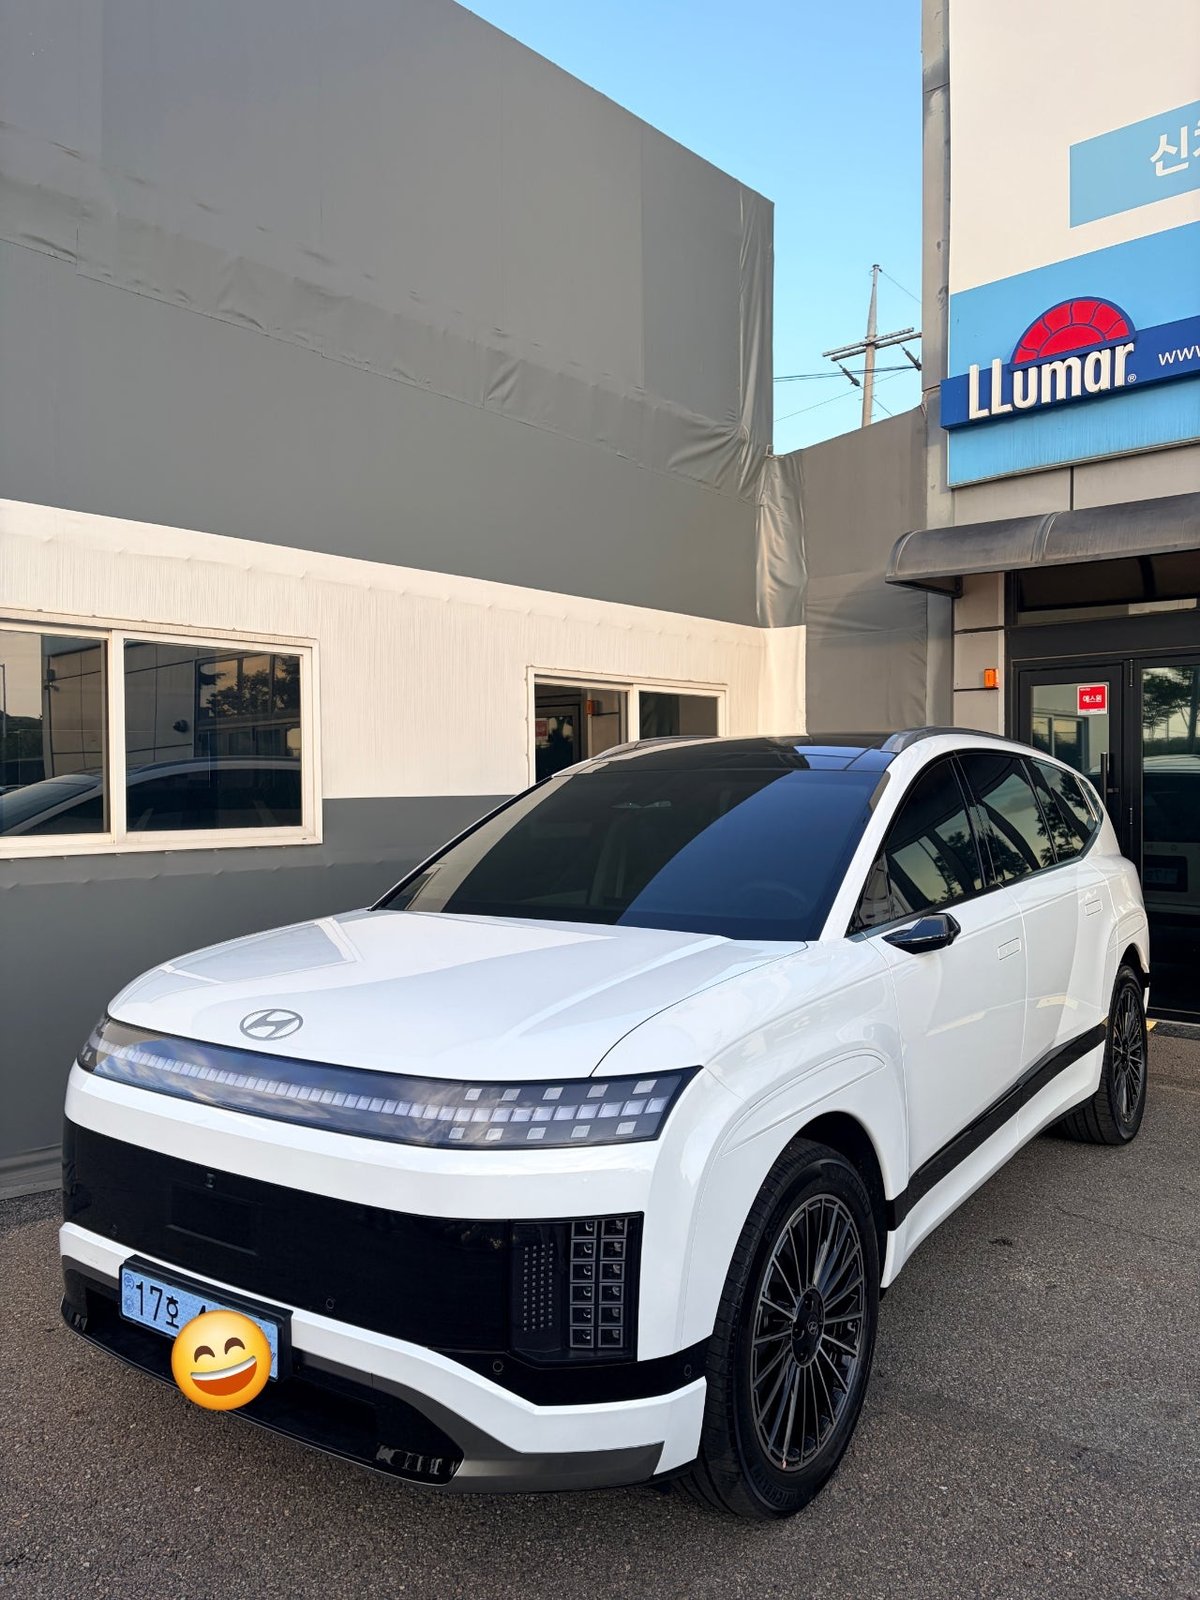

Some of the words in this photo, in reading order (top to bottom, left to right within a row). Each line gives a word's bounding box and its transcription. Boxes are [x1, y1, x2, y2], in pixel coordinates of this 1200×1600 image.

[1150, 120, 1200, 177] 신
[969, 342, 1135, 419] LLumar
[1158, 345, 1200, 366] ww
[136, 1281, 180, 1329] 17호
